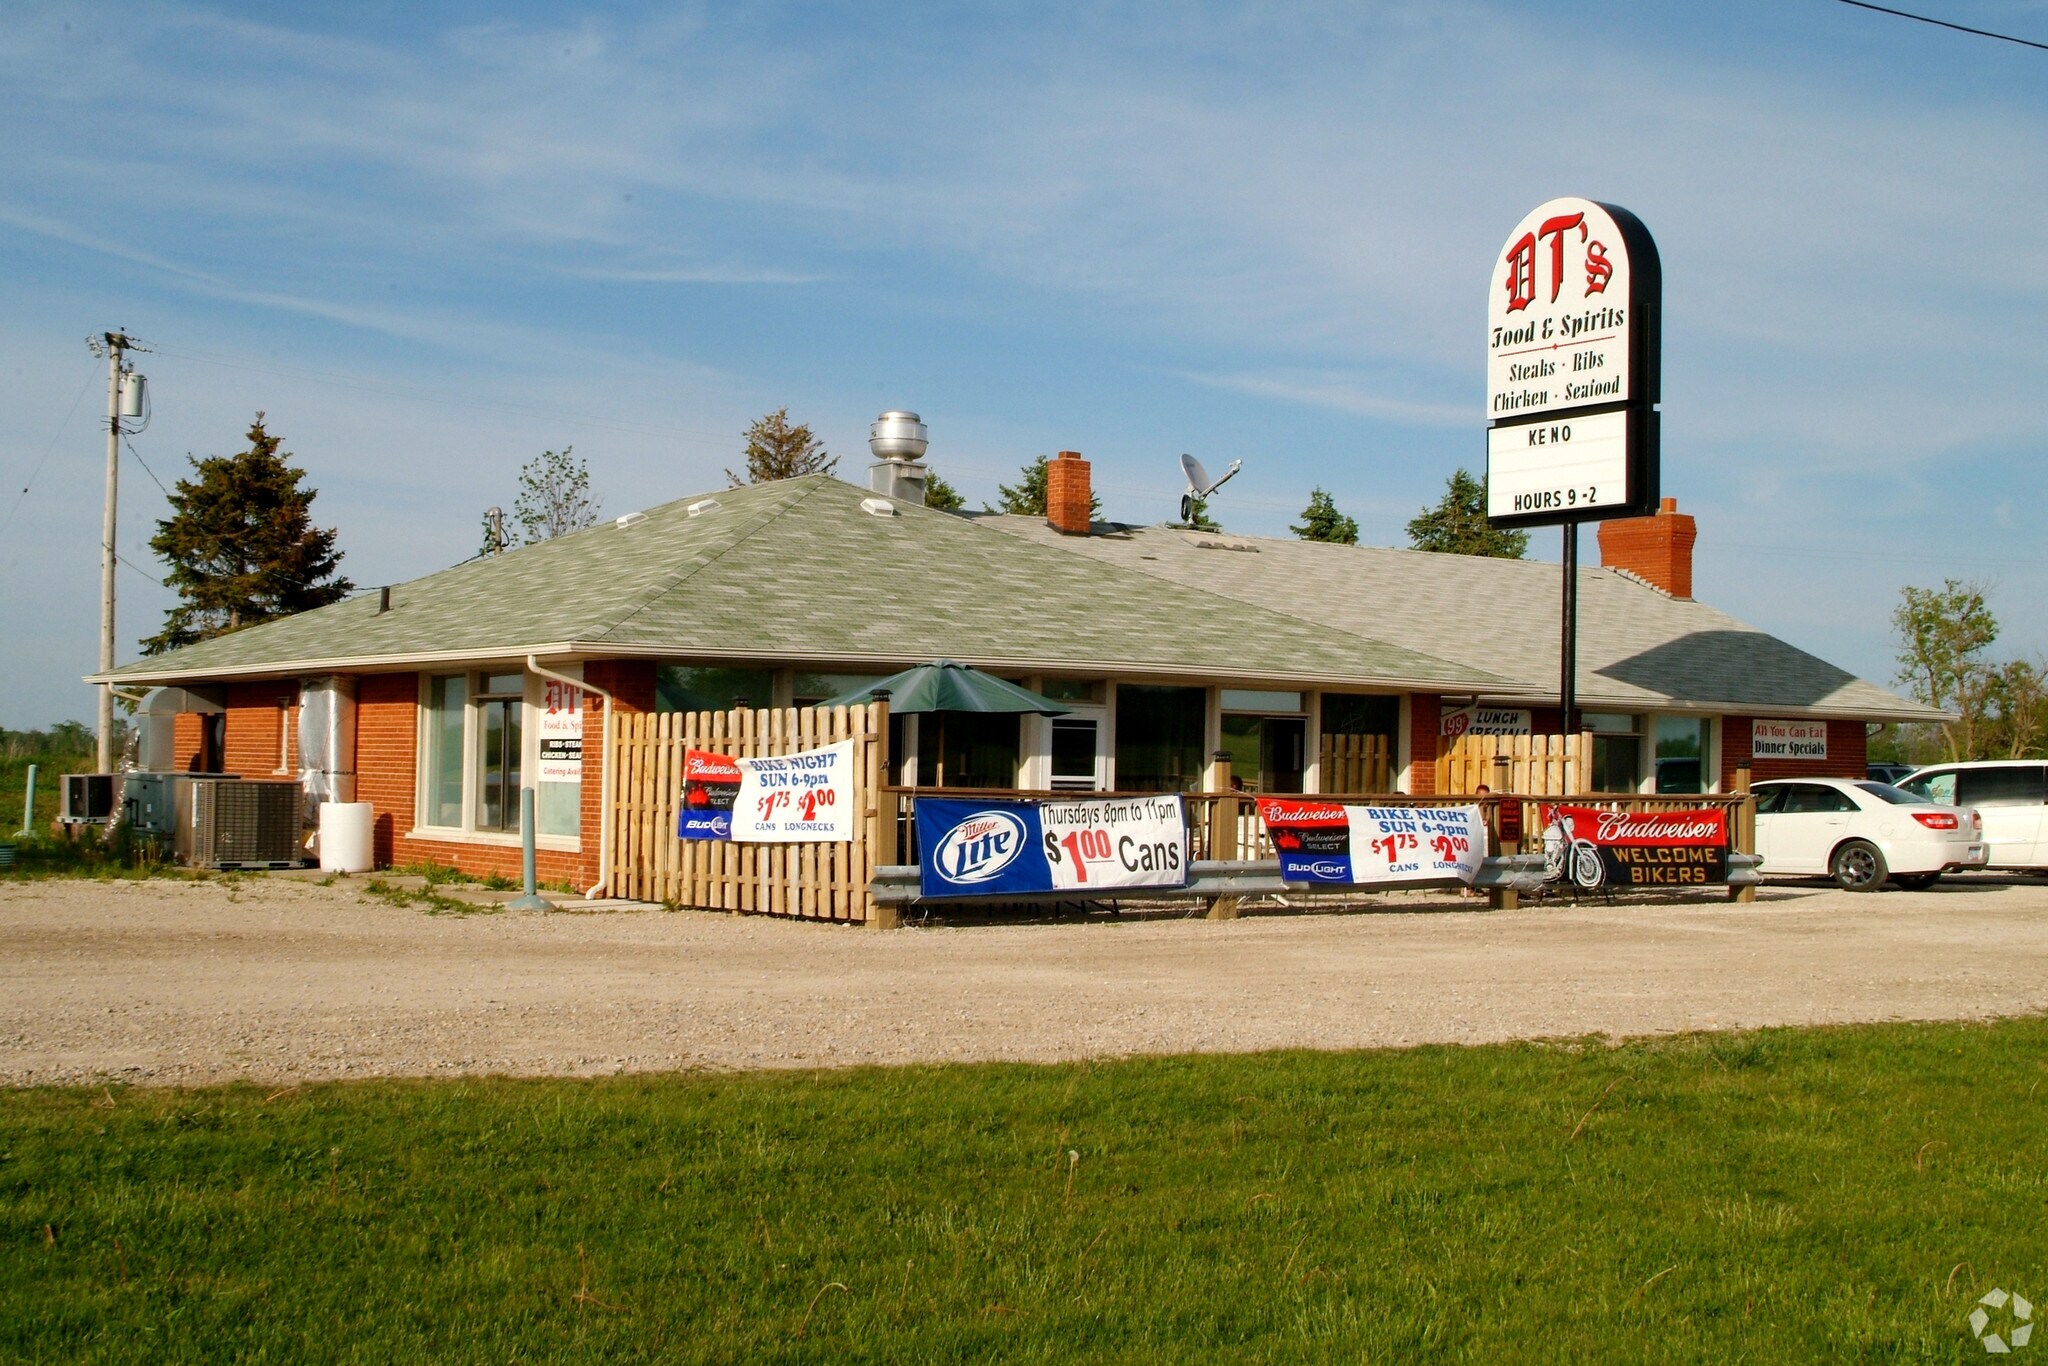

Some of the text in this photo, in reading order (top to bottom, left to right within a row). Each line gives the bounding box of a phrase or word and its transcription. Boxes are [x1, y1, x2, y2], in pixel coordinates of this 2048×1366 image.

[1492, 307, 1624, 348] Food & Spirits
[1509, 351, 1604, 382] Steaks Ribs
[1494, 375, 1620, 412] Chicken Seafood
[1529, 425, 1571, 446] KENO
[1515, 491, 1561, 511] HOURS
[544, 720, 561, 730] Food
[1476, 712, 1519, 724] LUNCH
[1755, 725, 1824, 738] All You Can Eat
[1755, 741, 1824, 756] Dinner Specials
[689, 758, 740, 775] Budweiser
[749, 753, 837, 771] BIKE NIGHT
[544, 767, 566, 777] Catering
[760, 772, 788, 787] SUN
[1041, 799, 1177, 829] Thursdays 8pm to 11pm
[1263, 805, 1347, 822] Budweiser
[1366, 808, 1468, 823] BIKE NIGHT
[755, 822, 834, 831] CANS LONGNECKS
[957, 821, 998, 839] Miller
[1379, 821, 1468, 836] SUN 6-9pm
[1597, 812, 1718, 841] Budweiser
[954, 830, 1011, 878] Lite
[1118, 835, 1179, 873] Cans
[1612, 847, 1718, 863] WELCOME
[1315, 865, 1346, 873] LIGHT
[1389, 863, 1419, 873] CANS
[1631, 867, 1705, 883] BIKERS
